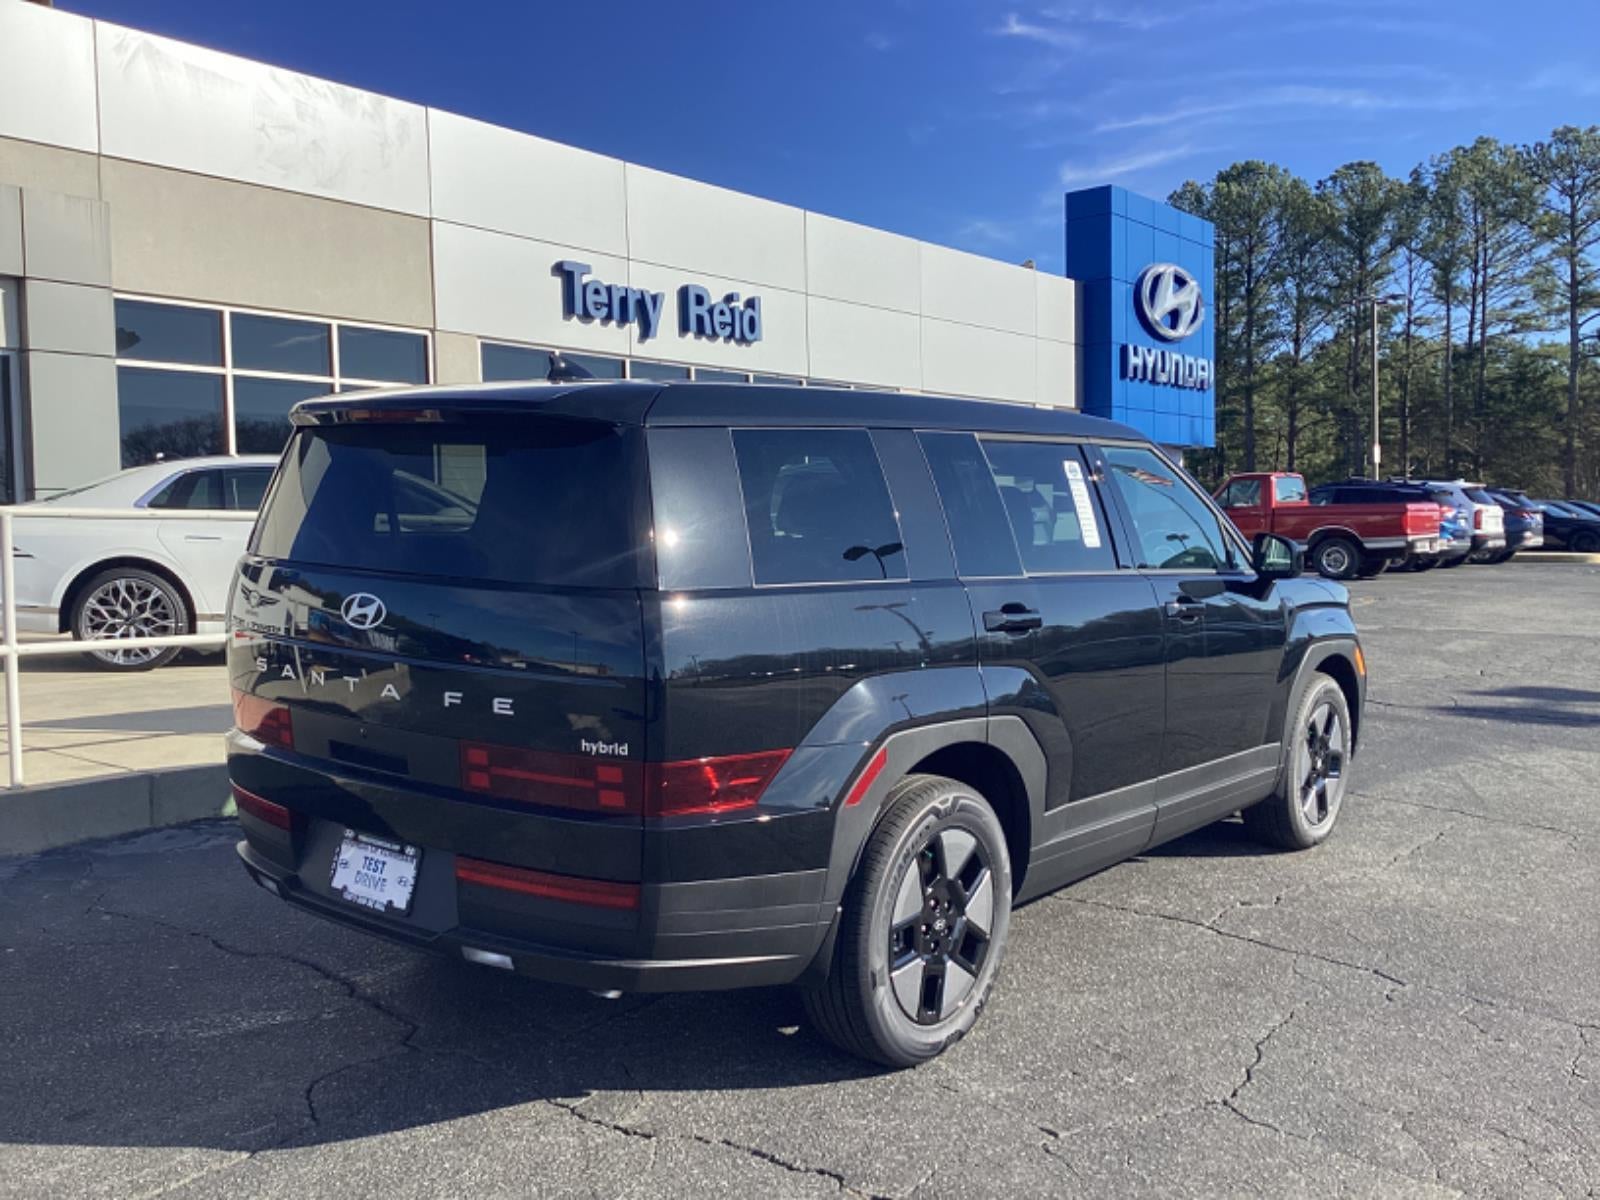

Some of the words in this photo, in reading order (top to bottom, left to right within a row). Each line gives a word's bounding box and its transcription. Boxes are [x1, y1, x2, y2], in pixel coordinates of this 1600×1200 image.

[551, 260, 665, 343] Terry
[676, 283, 763, 347] Reid
[1120, 343, 1215, 393] HYUNDAI
[256, 656, 400, 700] SANTA
[443, 691, 515, 716] FE
[581, 738, 629, 756] hybrid
[355, 870, 387, 893] DRIVE
[362, 855, 387, 875] TEST
